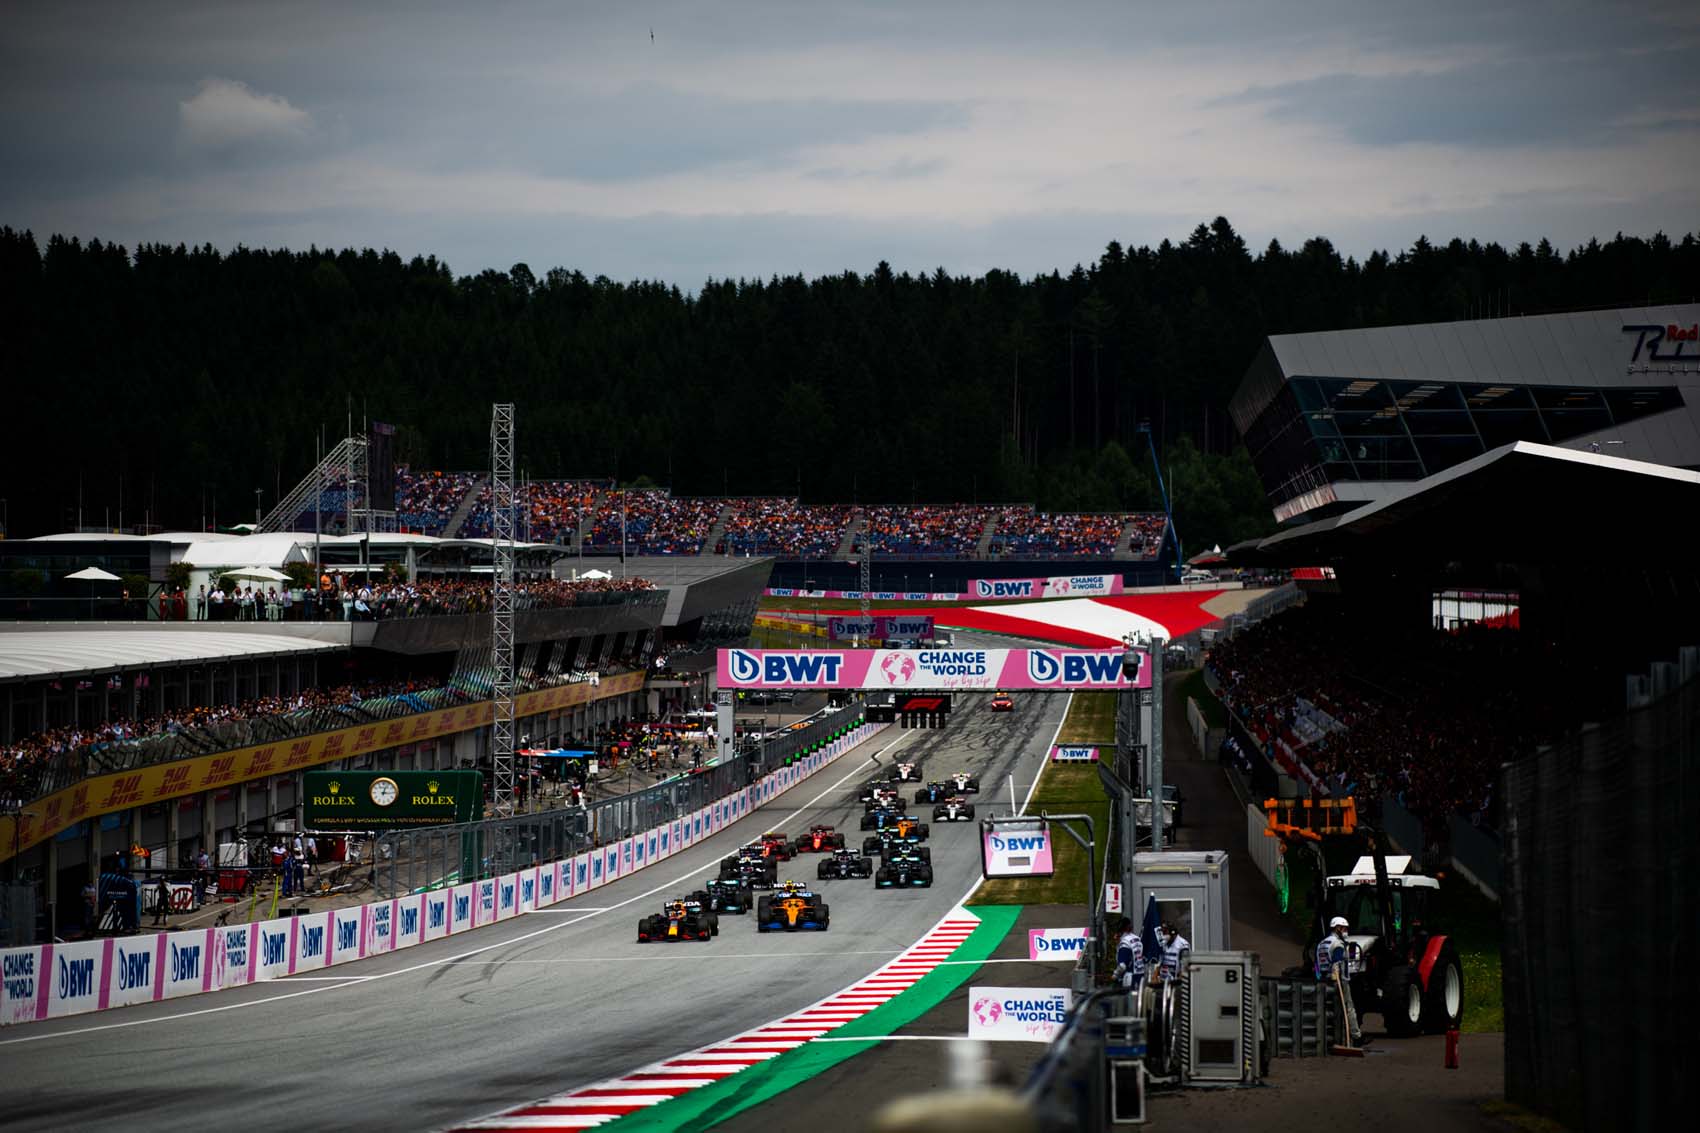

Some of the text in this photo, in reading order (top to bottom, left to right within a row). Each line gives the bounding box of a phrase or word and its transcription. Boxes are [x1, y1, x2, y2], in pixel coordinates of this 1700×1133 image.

[1666, 323, 1699, 342] Red
[1070, 576, 1104, 584] CHANGE
[995, 582, 1031, 596] BWT
[900, 623, 928, 634] BWT
[919, 652, 986, 664] CHANGE
[764, 655, 842, 682] BWT
[933, 665, 986, 675] WORLD
[1070, 750, 1089, 758] BWT
[313, 796, 355, 806] ROLEX
[412, 795, 454, 805] ROLEX
[1008, 837, 1045, 850] BWT
[405, 907, 418, 936] BWT
[226, 929, 247, 950] CHANGE
[308, 926, 323, 957] BWT
[343, 919, 357, 950] BWT
[269, 932, 286, 965] BWT
[1052, 938, 1087, 951] BWT
[3, 952, 34, 978] CHANGE
[180, 945, 200, 980] BWT
[230, 951, 247, 968] WORLD
[70, 958, 94, 998] BWT
[128, 952, 150, 989] BWT
[1225, 969, 1238, 983] B
[9, 978, 34, 1000] WORLD
[1004, 1000, 1065, 1012] CHANGE
[1016, 1012, 1067, 1024] WORLD
